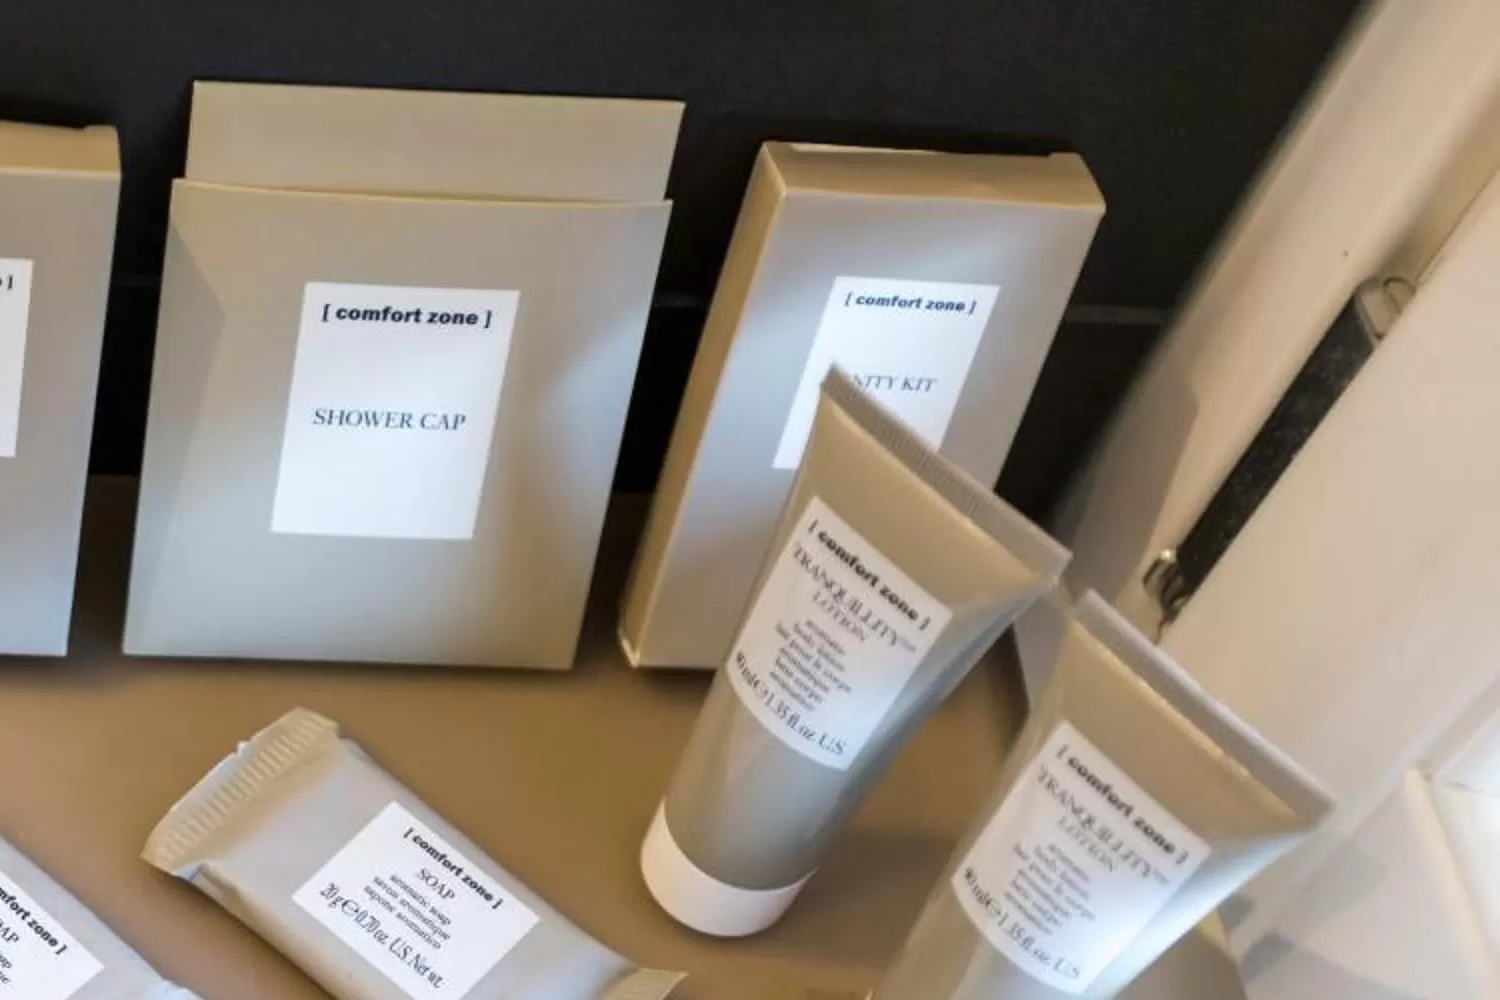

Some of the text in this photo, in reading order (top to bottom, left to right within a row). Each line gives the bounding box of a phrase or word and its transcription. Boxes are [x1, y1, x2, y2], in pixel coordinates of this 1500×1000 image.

[335, 306, 422, 324] comfort
[427, 310, 479, 326] zone
[856, 295, 922, 309] comfort
[925, 299, 966, 312] zone
[900, 376, 938, 392] KIT
[313, 408, 467, 431] SHOWER CAP
[814, 525, 881, 589] comfort
[877, 582, 921, 624] zone
[410, 832, 465, 877] comfort
[460, 873, 495, 903] zone
[414, 867, 457, 903] SOAP
[25, 917, 60, 948] zone
